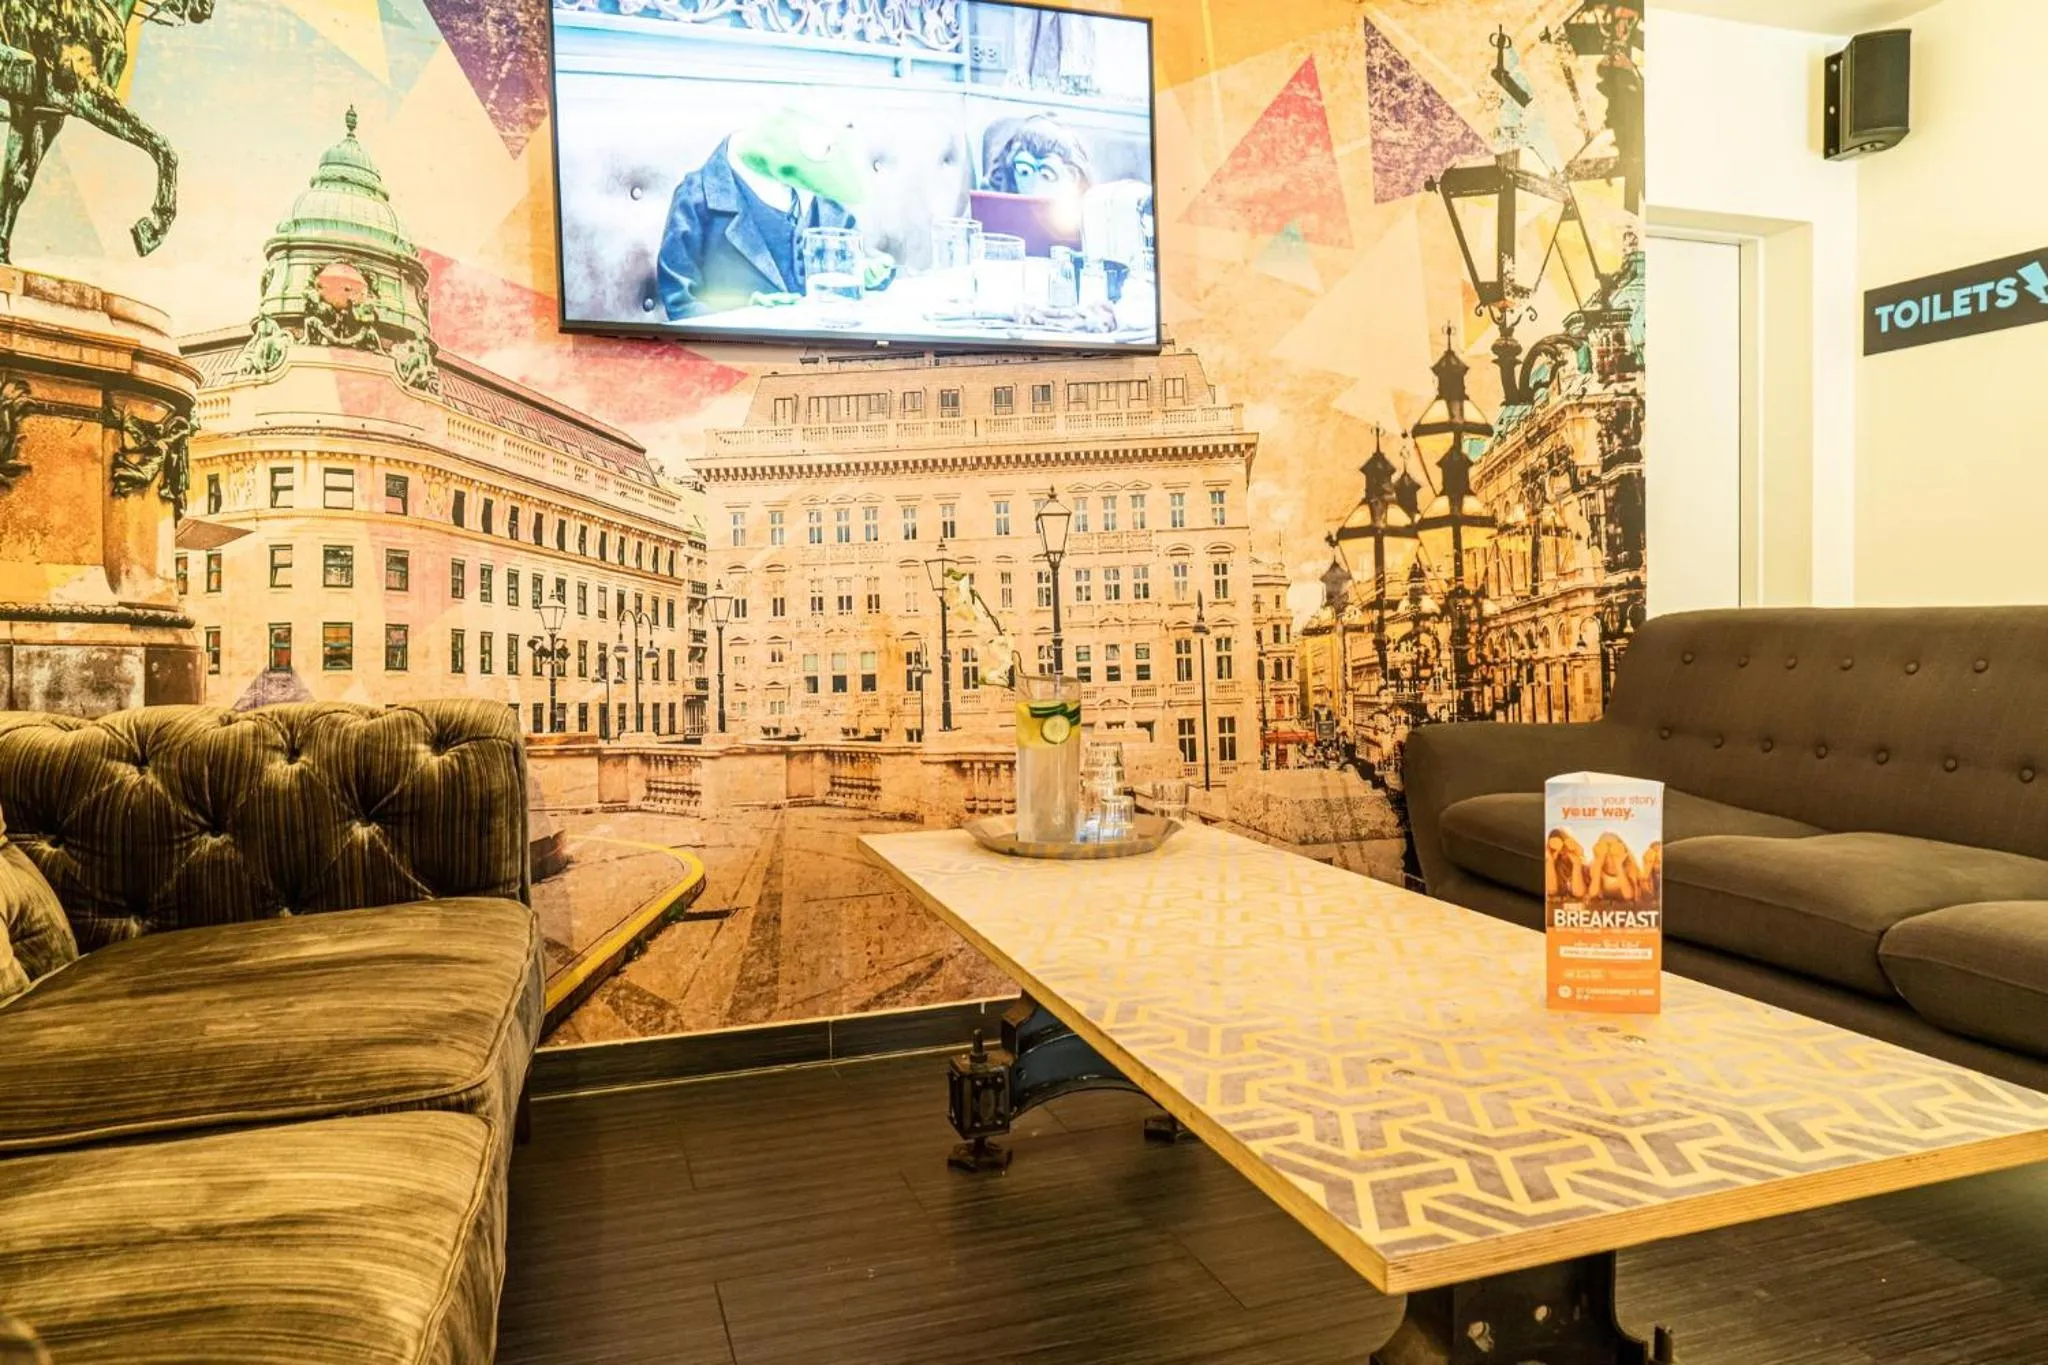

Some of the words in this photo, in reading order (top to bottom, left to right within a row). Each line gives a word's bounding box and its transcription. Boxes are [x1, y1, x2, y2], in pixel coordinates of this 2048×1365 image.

[1874, 276, 2019, 333] TOILETS
[1562, 806, 1598, 820] your
[1601, 806, 1635, 820] way.
[1554, 908, 1659, 929] BREAKFAST
